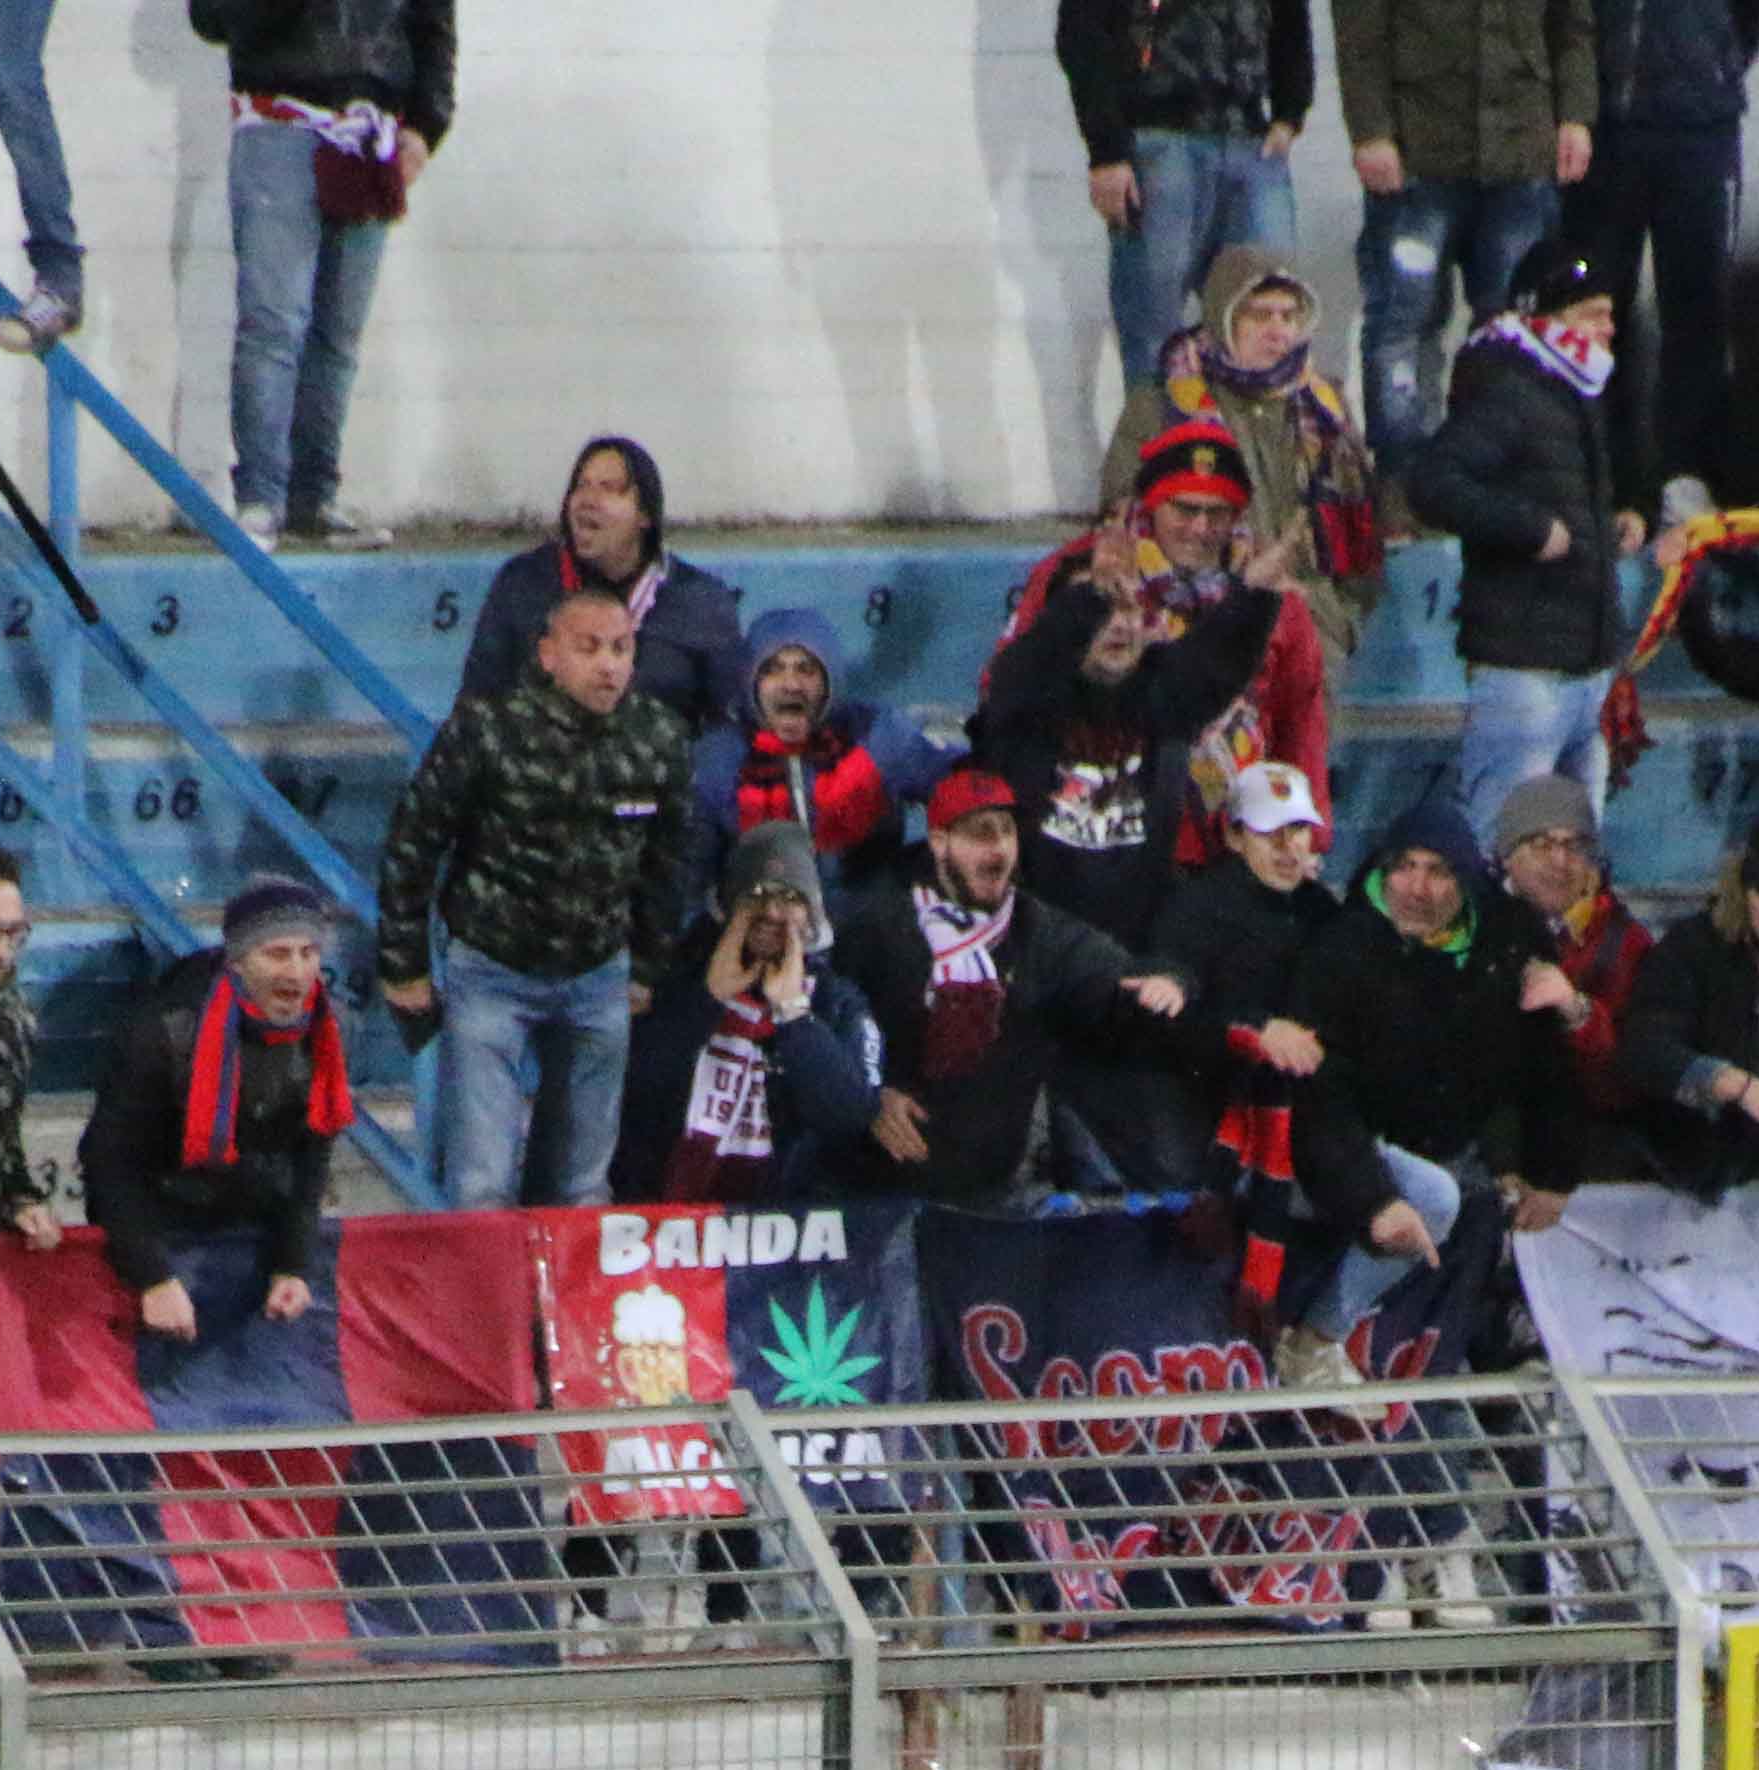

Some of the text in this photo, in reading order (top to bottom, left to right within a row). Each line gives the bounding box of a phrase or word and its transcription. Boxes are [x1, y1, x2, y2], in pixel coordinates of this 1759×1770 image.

[3, 583, 892, 639] 2 3 5 8
[599, 1208, 849, 1276] BANDA
